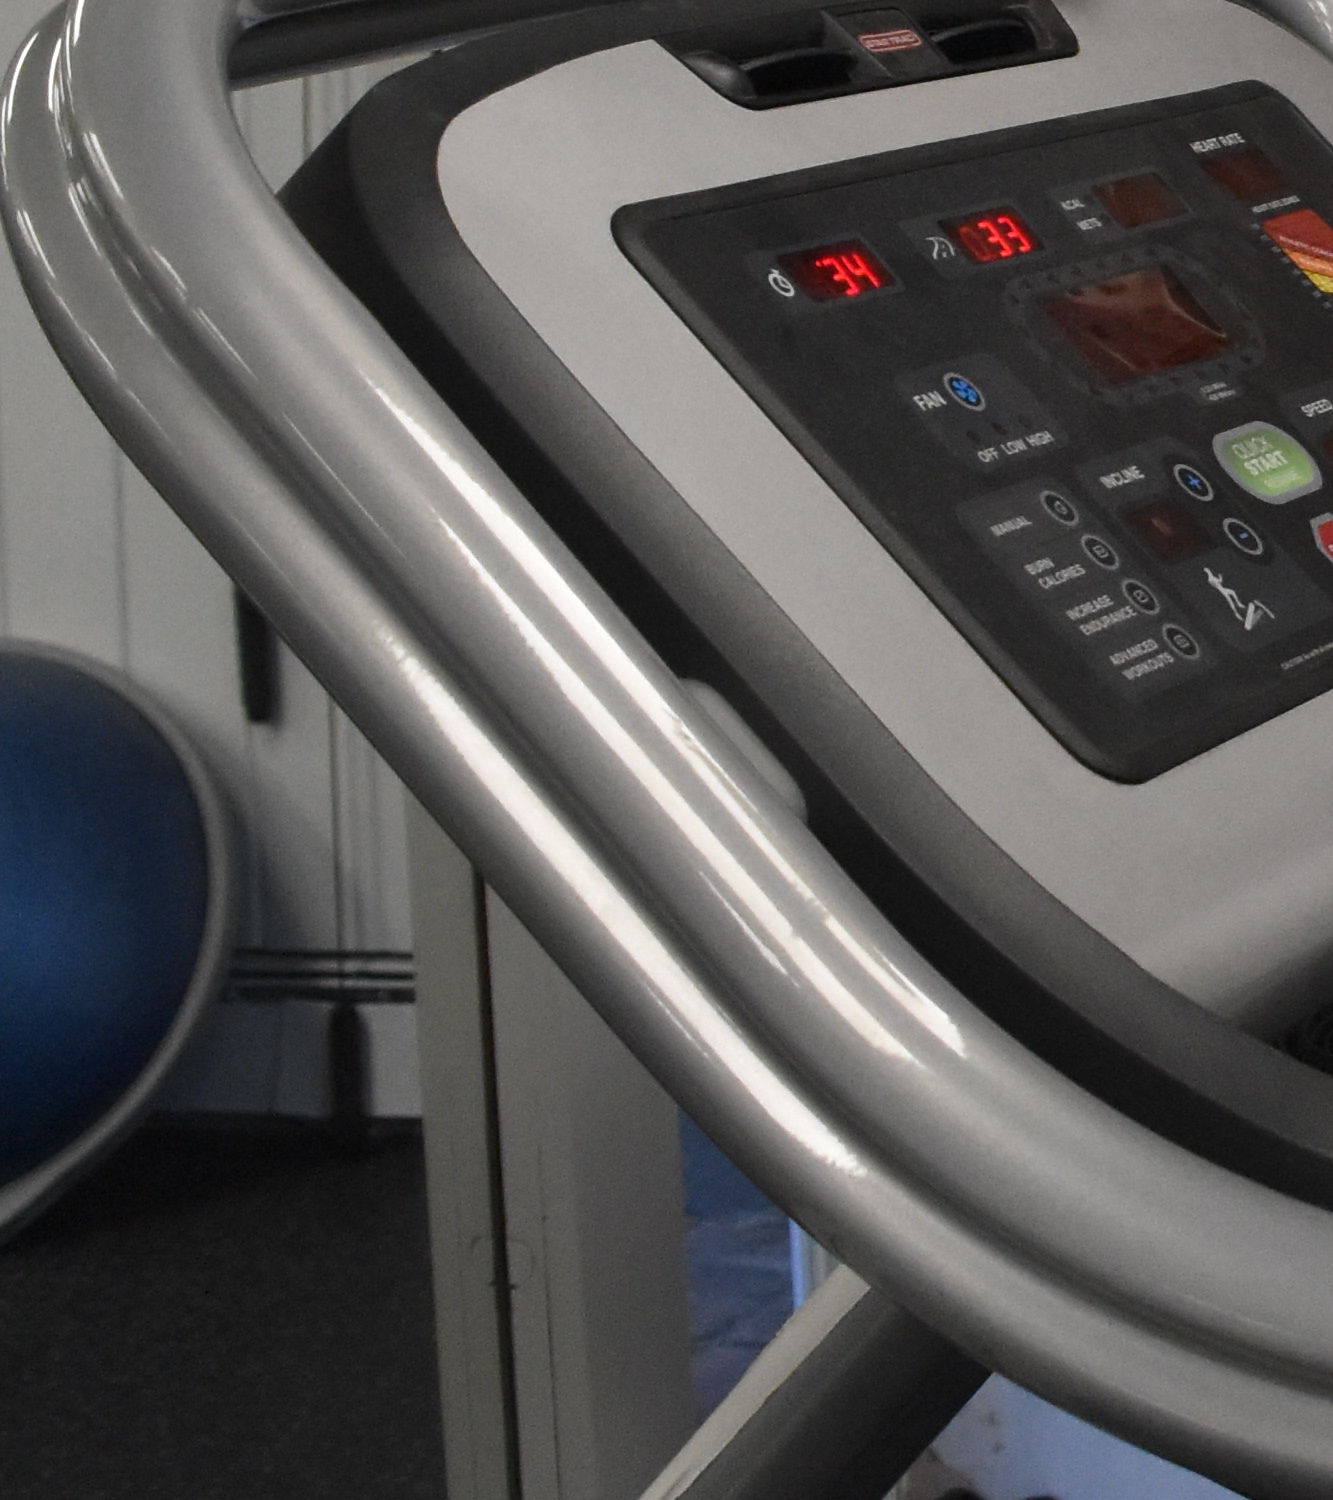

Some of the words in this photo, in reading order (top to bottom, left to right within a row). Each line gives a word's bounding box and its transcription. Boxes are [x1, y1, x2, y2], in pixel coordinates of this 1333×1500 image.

[1189, 137, 1221, 154] HEART
[1219, 132, 1246, 148] RATE
[912, 390, 948, 412] FAN
[977, 446, 1000, 463] OFF
[1000, 438, 1028, 456] LOW
[1025, 430, 1055, 448] HIGH
[1231, 435, 1275, 460] QUICK
[1243, 450, 1288, 477] START
[1100, 465, 1145, 489] INCLINE
[1024, 557, 1055, 576] BURN
[1038, 563, 1086, 590] CALORIES
[1066, 594, 1115, 620] INCREASE
[1079, 605, 1137, 636] ENDURANCE
[1109, 638, 1159, 666] ADVANCED
[1122, 651, 1175, 680] WORKOUTS
